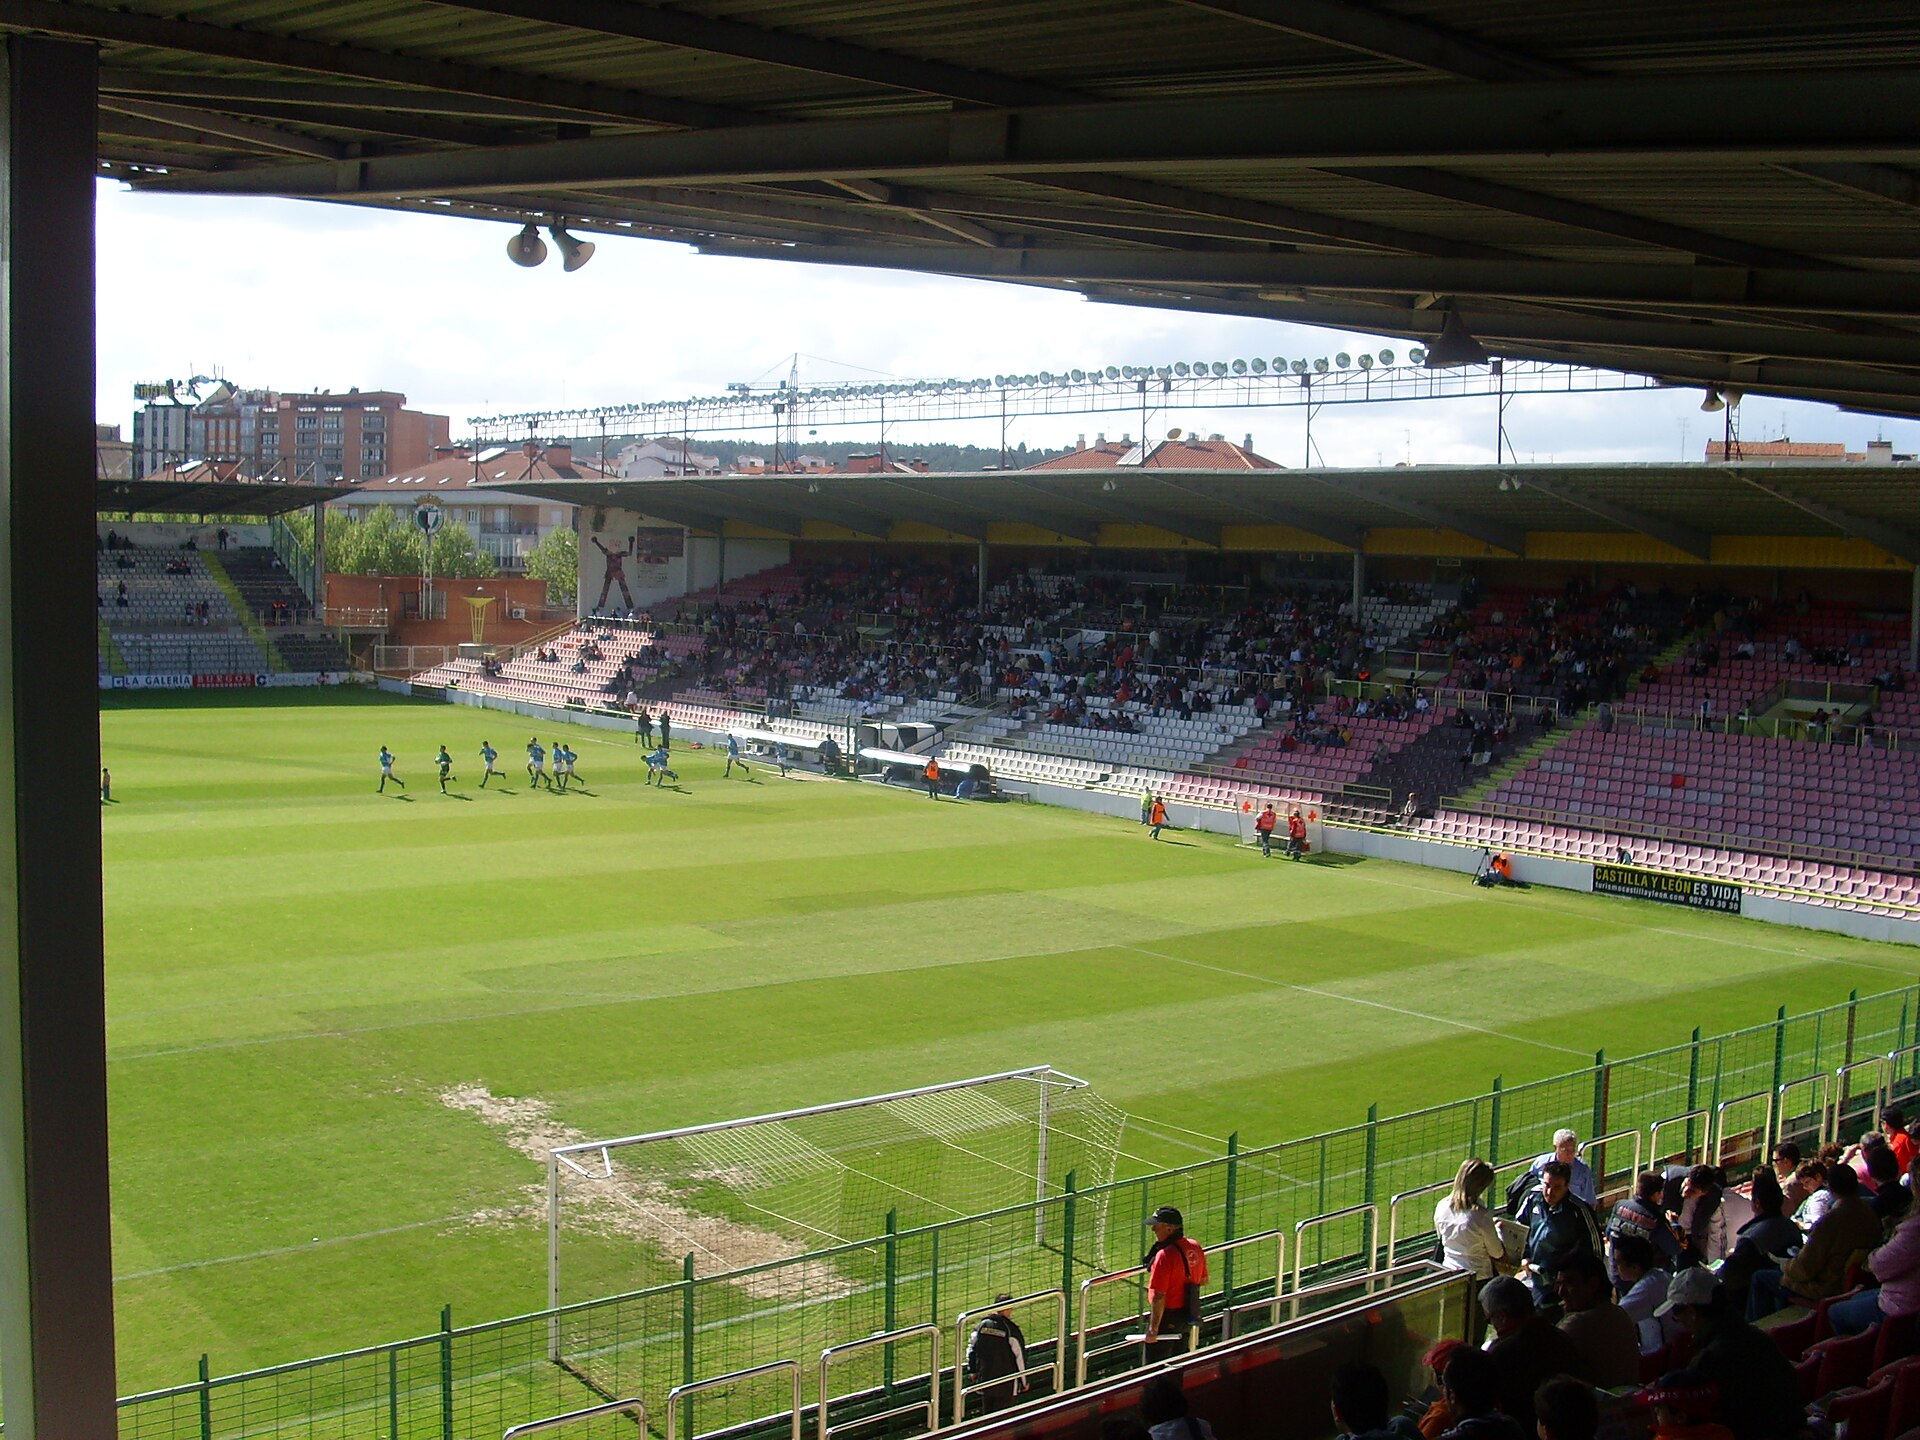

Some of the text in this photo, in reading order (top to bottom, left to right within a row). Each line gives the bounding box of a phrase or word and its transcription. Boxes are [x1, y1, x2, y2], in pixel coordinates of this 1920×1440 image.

[125, 676, 139, 686] LA
[197, 675, 252, 684] BURGOS
[1595, 868, 1740, 901] CASTILLA Y LEÓN ES VIDA
[1689, 896, 1702, 905] 902
[1717, 900, 1726, 909] 30
[1729, 902, 1739, 910] 30
[1647, 1391, 1680, 1402] PARIS
